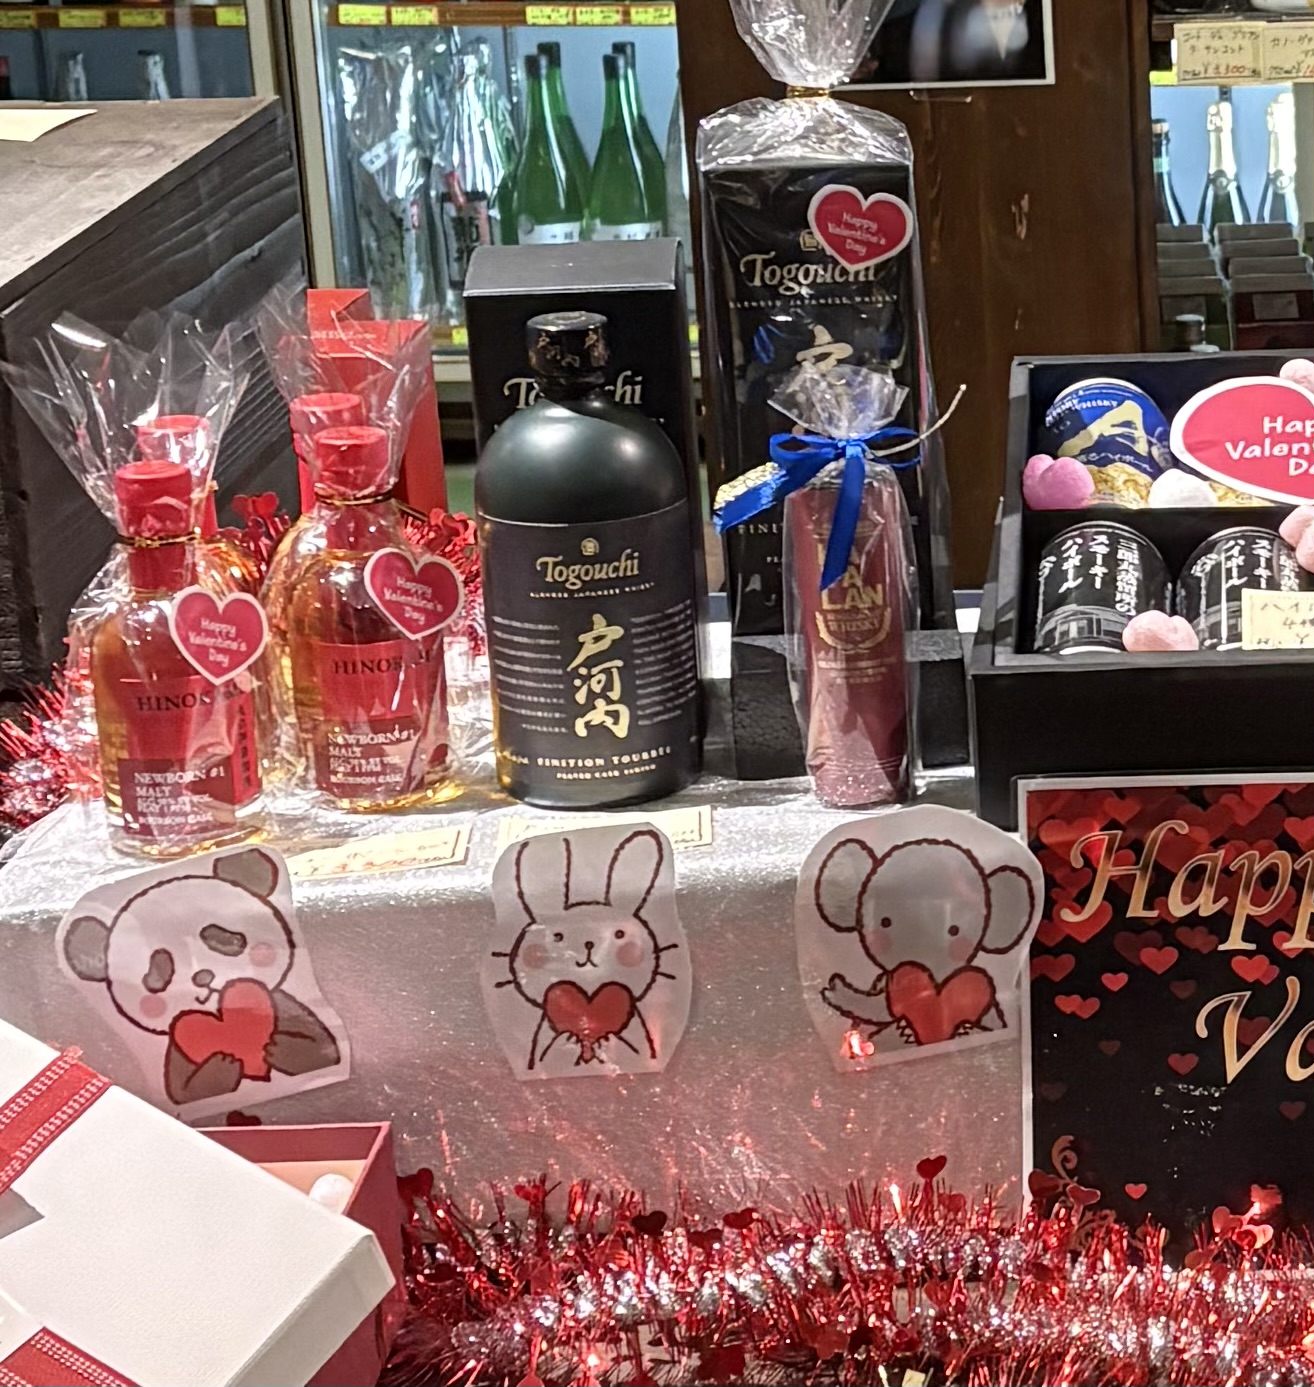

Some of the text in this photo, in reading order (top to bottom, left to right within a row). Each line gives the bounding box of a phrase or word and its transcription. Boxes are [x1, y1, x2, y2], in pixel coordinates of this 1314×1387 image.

[843, 212, 878, 233] Happy
[827, 222, 886, 246] Valentine's
[845, 239, 867, 256] Day
[535, 549, 640, 590] Togouchi
[397, 576, 433, 599] Happy
[383, 587, 444, 613] Valentine's
[404, 605, 426, 625] Day
[200, 617, 237, 637] Happy
[188, 630, 247, 652] Valentine's
[208, 647, 230, 667] Day
[329, 746, 361, 758] MALT
[134, 770, 206, 784] NEWBORN
[135, 785, 171, 798] MALT
